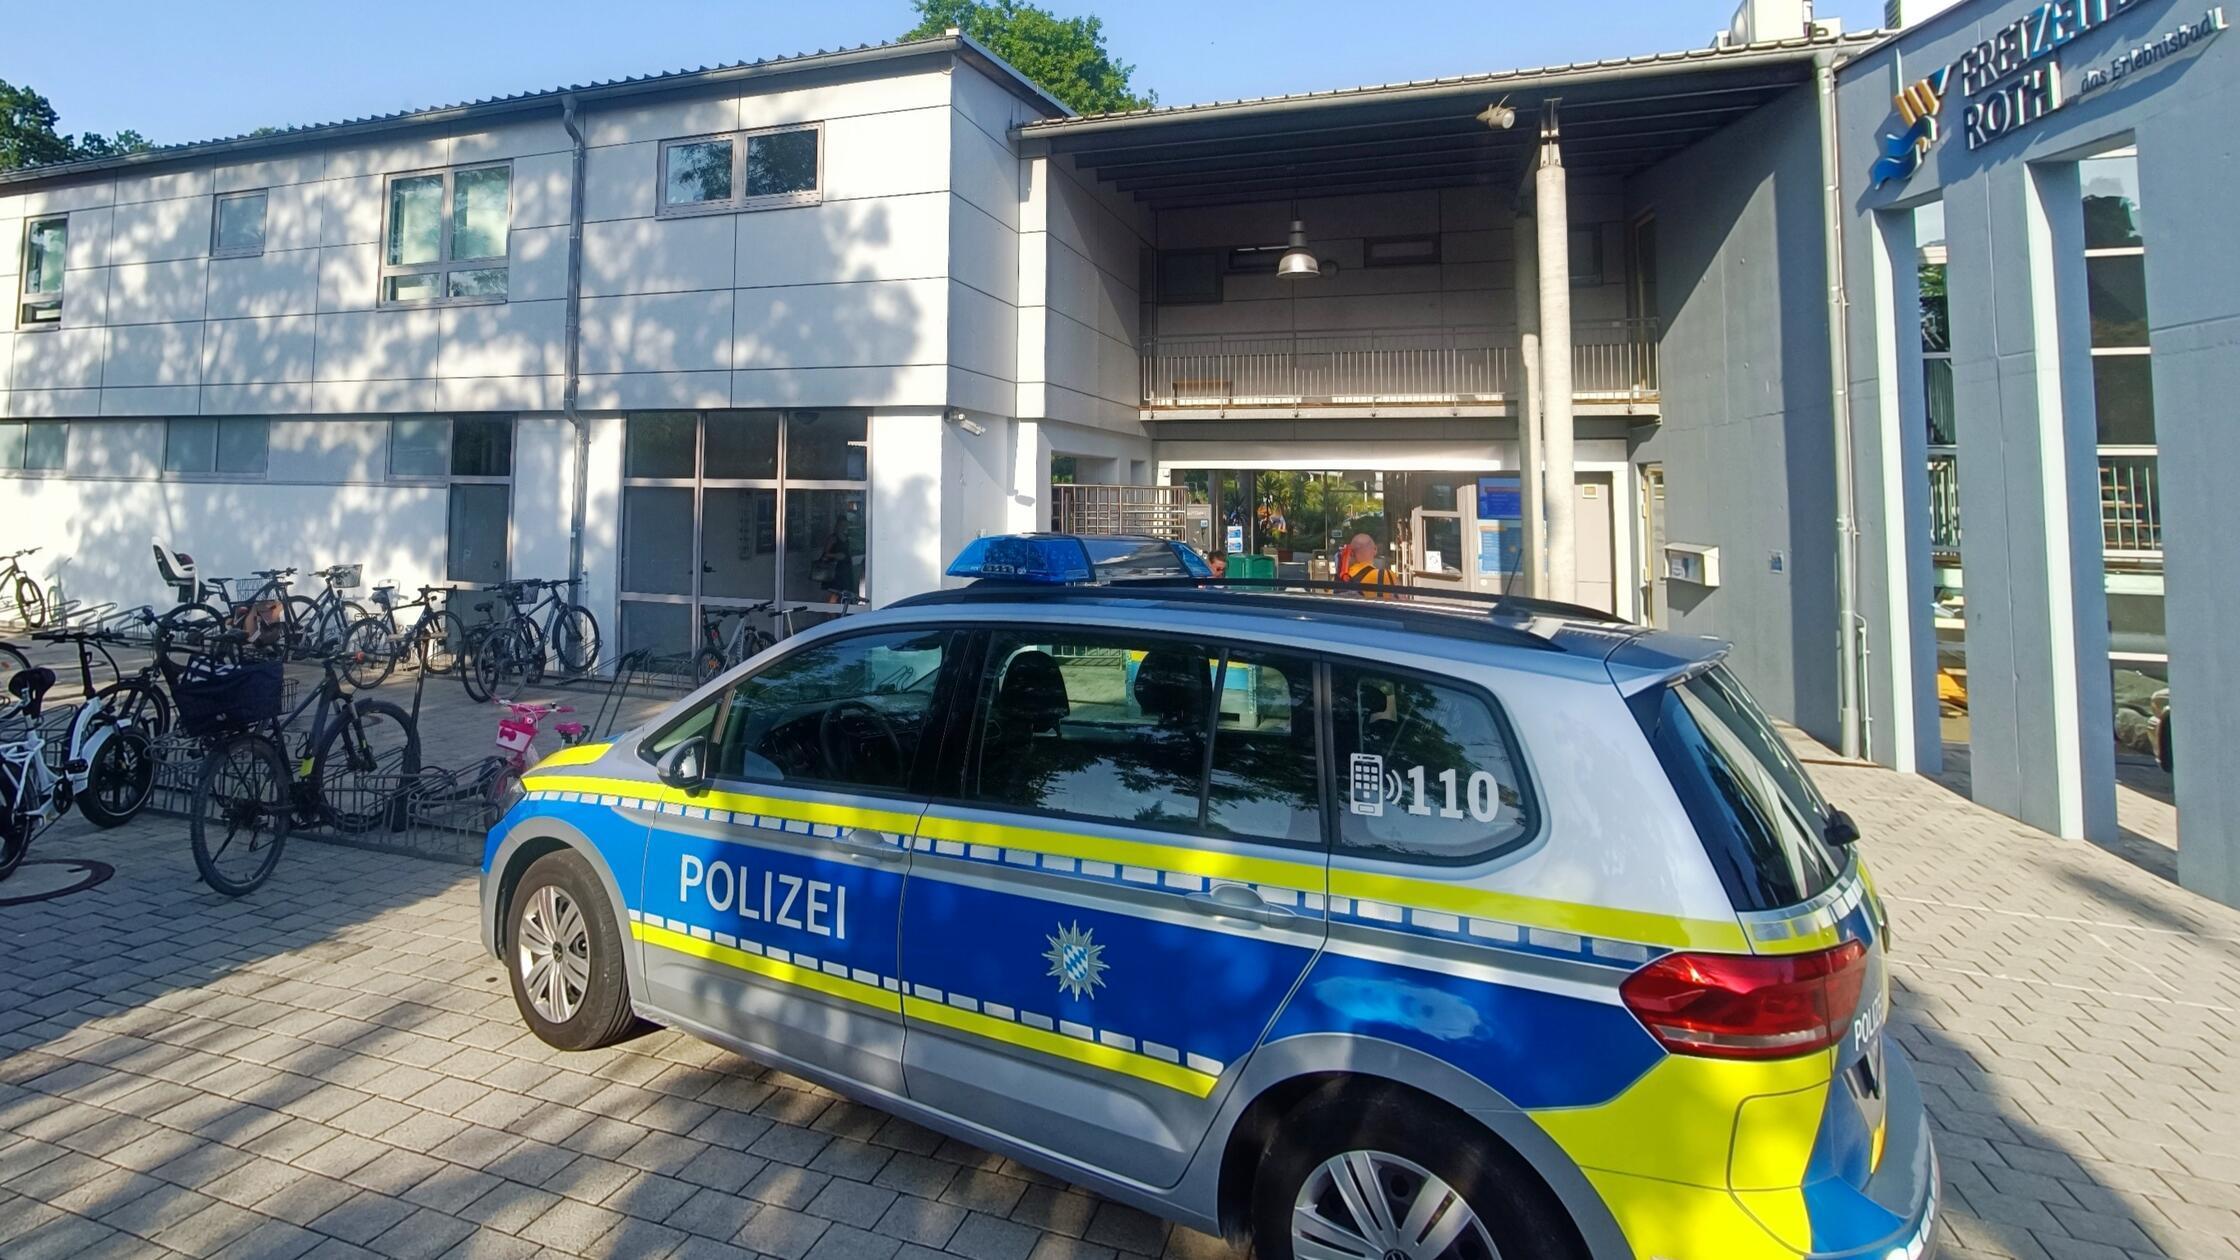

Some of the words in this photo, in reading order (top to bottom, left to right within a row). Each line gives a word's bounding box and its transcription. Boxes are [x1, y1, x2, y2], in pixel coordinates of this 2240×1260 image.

[2081, 70, 2107, 94] das
[2111, 9, 2214, 81] Erlebnisbad
[1963, 61, 2062, 150] ROTH
[1408, 765, 1499, 823] 110
[680, 854, 846, 940] POLIZEI
